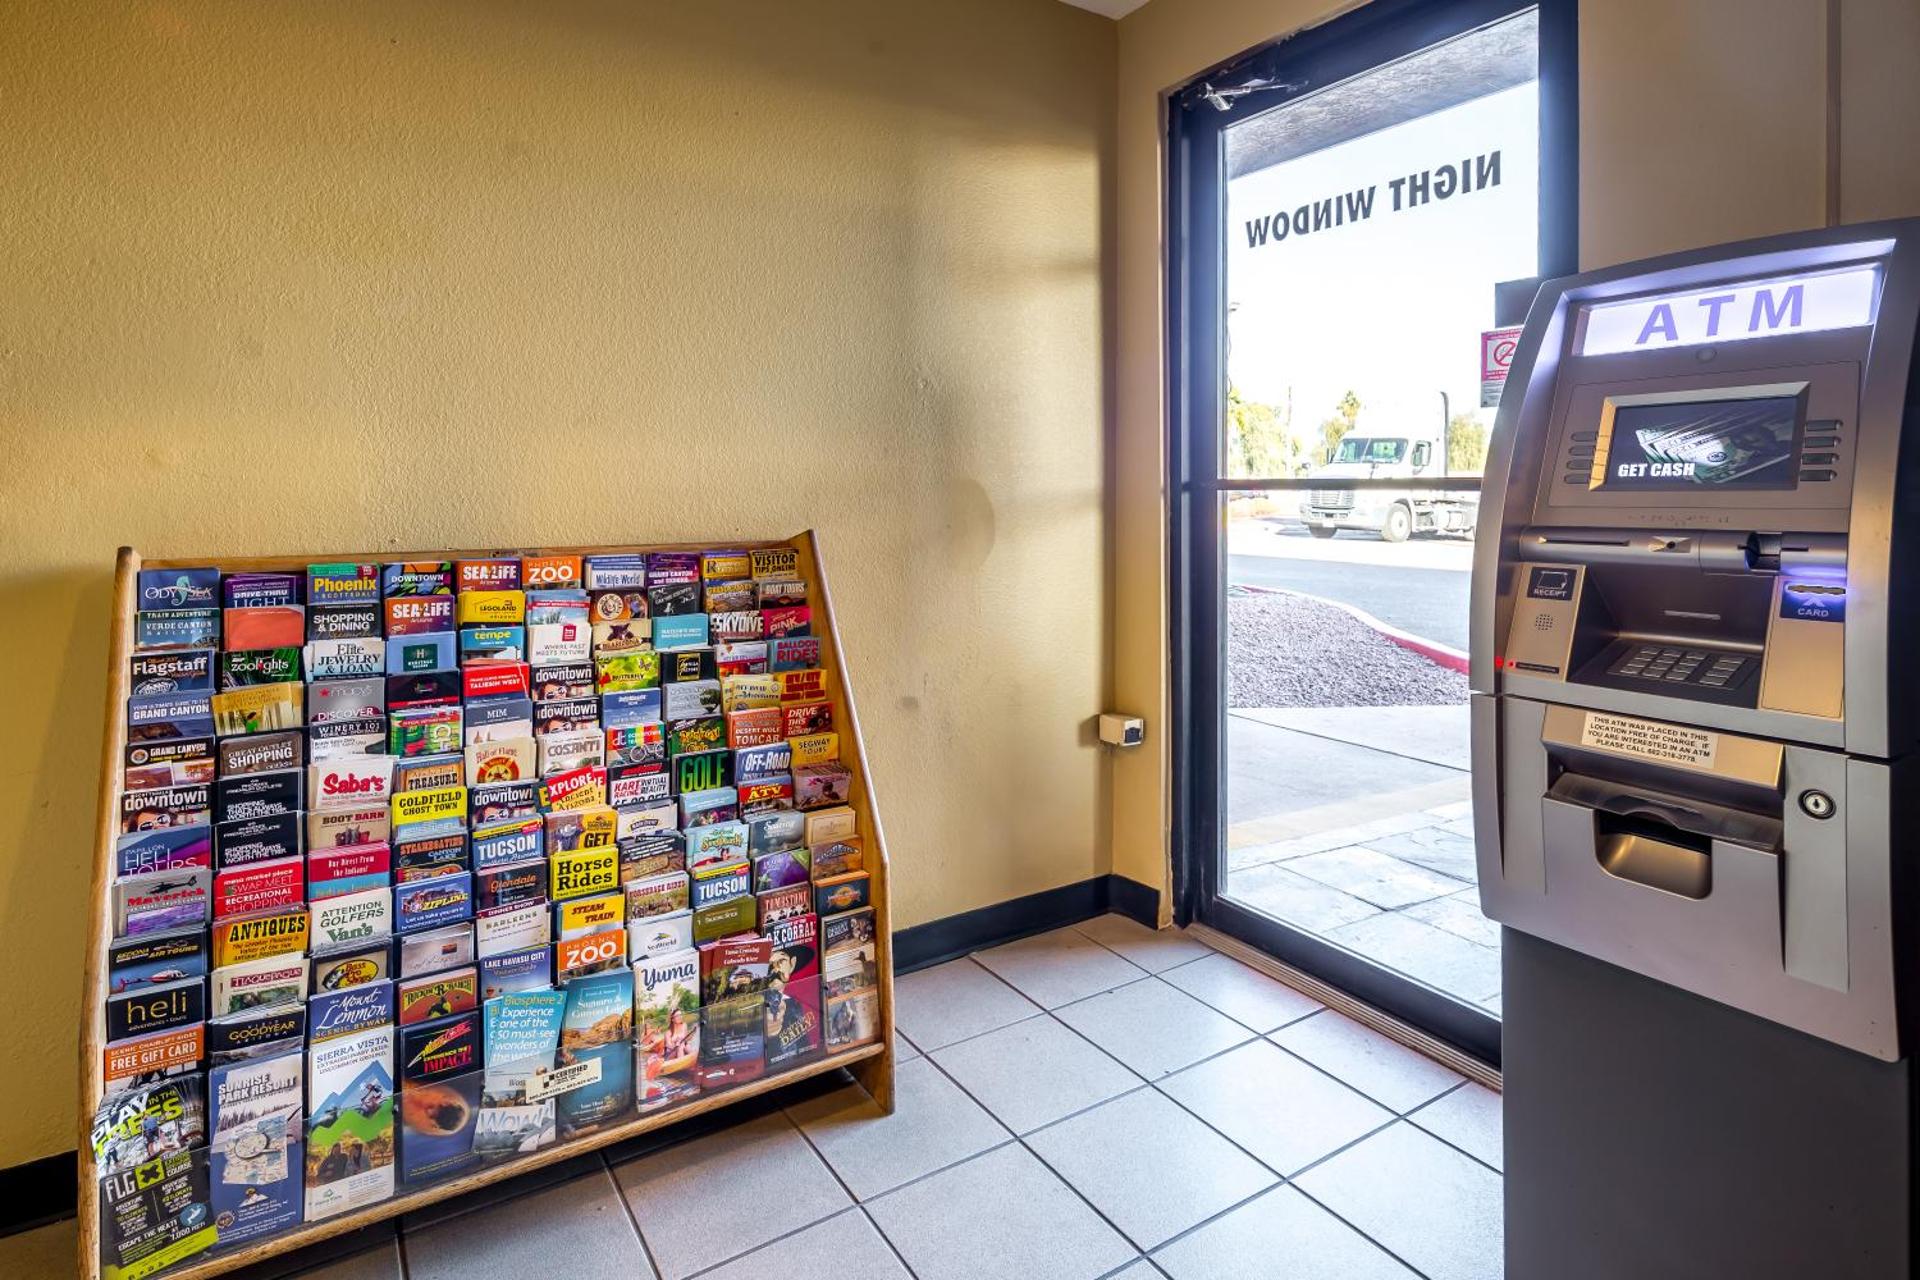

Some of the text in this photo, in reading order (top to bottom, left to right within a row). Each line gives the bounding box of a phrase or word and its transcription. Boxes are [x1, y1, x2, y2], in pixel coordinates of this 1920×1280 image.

[1635, 285, 1804, 344] ATM
[1618, 463, 1695, 477] GET CASH
[755, 554, 795, 566] VISITOR
[392, 574, 443, 582] DOWNTOWN
[528, 566, 573, 582] ZOO
[621, 573, 640, 584] World
[314, 577, 376, 592] Phoenix
[1534, 587, 1566, 598] RECEIPT
[480, 604, 517, 612] LEGOLAND
[1797, 607, 1829, 618] CARD
[313, 613, 374, 624] SHOPPING
[328, 622, 370, 631] DINING
[717, 616, 764, 632] SKYDIVE
[770, 618, 799, 632] PINK
[474, 630, 511, 640] tempe
[337, 644, 364, 655] Elite
[133, 657, 208, 676] Flagstaff
[318, 655, 380, 665] JEWELRY
[343, 663, 373, 673] LOAN
[536, 666, 592, 682] downtown
[133, 704, 209, 720] GRAND CANYON
[318, 708, 373, 721] DISCOVER
[487, 708, 507, 719] MIM
[789, 706, 818, 717] DRIVE
[319, 724, 361, 734] WINERY
[1590, 723, 1627, 734] LOCATION
[1628, 730, 1648, 738] FREE
[1594, 716, 1609, 724] THIS
[1611, 719, 1626, 727] ATM
[1647, 726, 1678, 736] PLACED
[1690, 733, 1708, 741] THIS
[736, 735, 780, 744] TOMCAR
[1596, 739, 1624, 749] PLEASE
[1626, 744, 1645, 753] CALL
[1621, 737, 1667, 750] INTERESTED
[1693, 749, 1710, 757] ATM
[151, 743, 206, 757] GRAND CANYON
[229, 748, 292, 769] SHOPPING
[745, 752, 790, 771] OFF-ROAD
[408, 773, 458, 790] TREASURE
[682, 753, 728, 795] GOLF
[323, 773, 384, 794] Saba's
[614, 780, 640, 792] KART
[125, 790, 207, 811] downtown
[399, 791, 462, 808] GOLDFIELD
[749, 786, 782, 799] ATV
[403, 803, 458, 816] GHOST TOWN
[322, 812, 384, 824] BOOT BARN
[478, 834, 536, 861] TUCSON
[584, 832, 609, 848] GET
[557, 858, 613, 876] Horse
[557, 872, 612, 892] Rides
[699, 877, 747, 901] TUCSON
[225, 887, 291, 905] RECREATIONAL
[321, 901, 382, 918] ATTENTION
[572, 903, 605, 915] STEAM
[585, 911, 615, 923] TRAIN
[320, 908, 384, 928] GOLFERS
[229, 917, 305, 942] ANTIQUES
[327, 923, 373, 942] Van's
[782, 924, 816, 941] CORRAL
[484, 951, 545, 968] LAKE HAVASU CITY
[567, 941, 617, 968] ZOO
[641, 961, 696, 991] Yuma
[127, 991, 186, 1024] heli
[502, 1007, 553, 1017] Experience
[229, 1020, 295, 1039] GOODYEAR
[500, 1017, 548, 1027] one of the
[317, 1035, 388, 1063] SIERRA VISTA
[495, 1040, 533, 1050] wonders
[110, 1054, 138, 1071] FREE
[141, 1048, 165, 1063] GIFT
[168, 1042, 196, 1056] CARD
[219, 1089, 249, 1105] PARK
[106, 1172, 135, 1203] FLG
